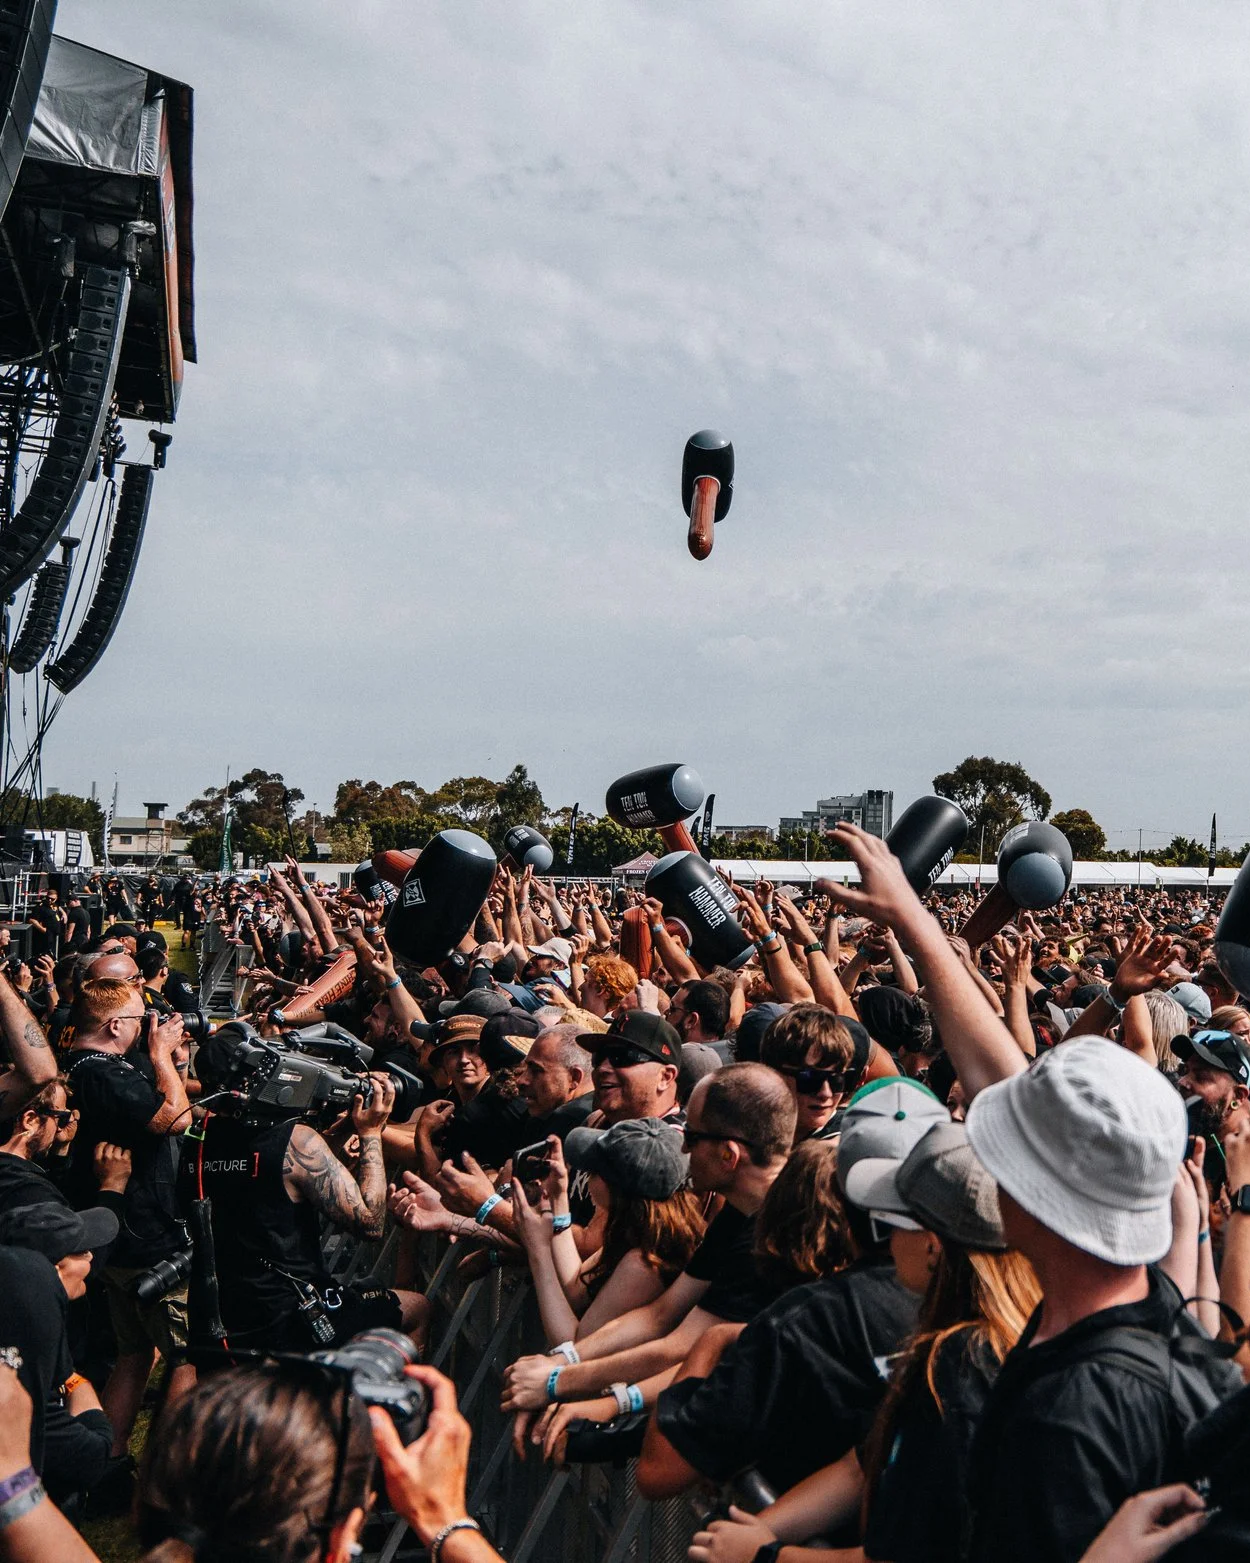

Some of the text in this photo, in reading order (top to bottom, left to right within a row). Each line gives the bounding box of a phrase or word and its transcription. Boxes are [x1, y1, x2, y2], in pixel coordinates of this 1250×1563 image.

[620, 791, 648, 812] TEN TON
[703, 826, 711, 847] BAR
[567, 832, 576, 865] WATER
[928, 863, 942, 885] TEN
[706, 875, 727, 898] TEN
[688, 885, 727, 930] HAMMER
[203, 1159, 248, 1172] PICTURE
